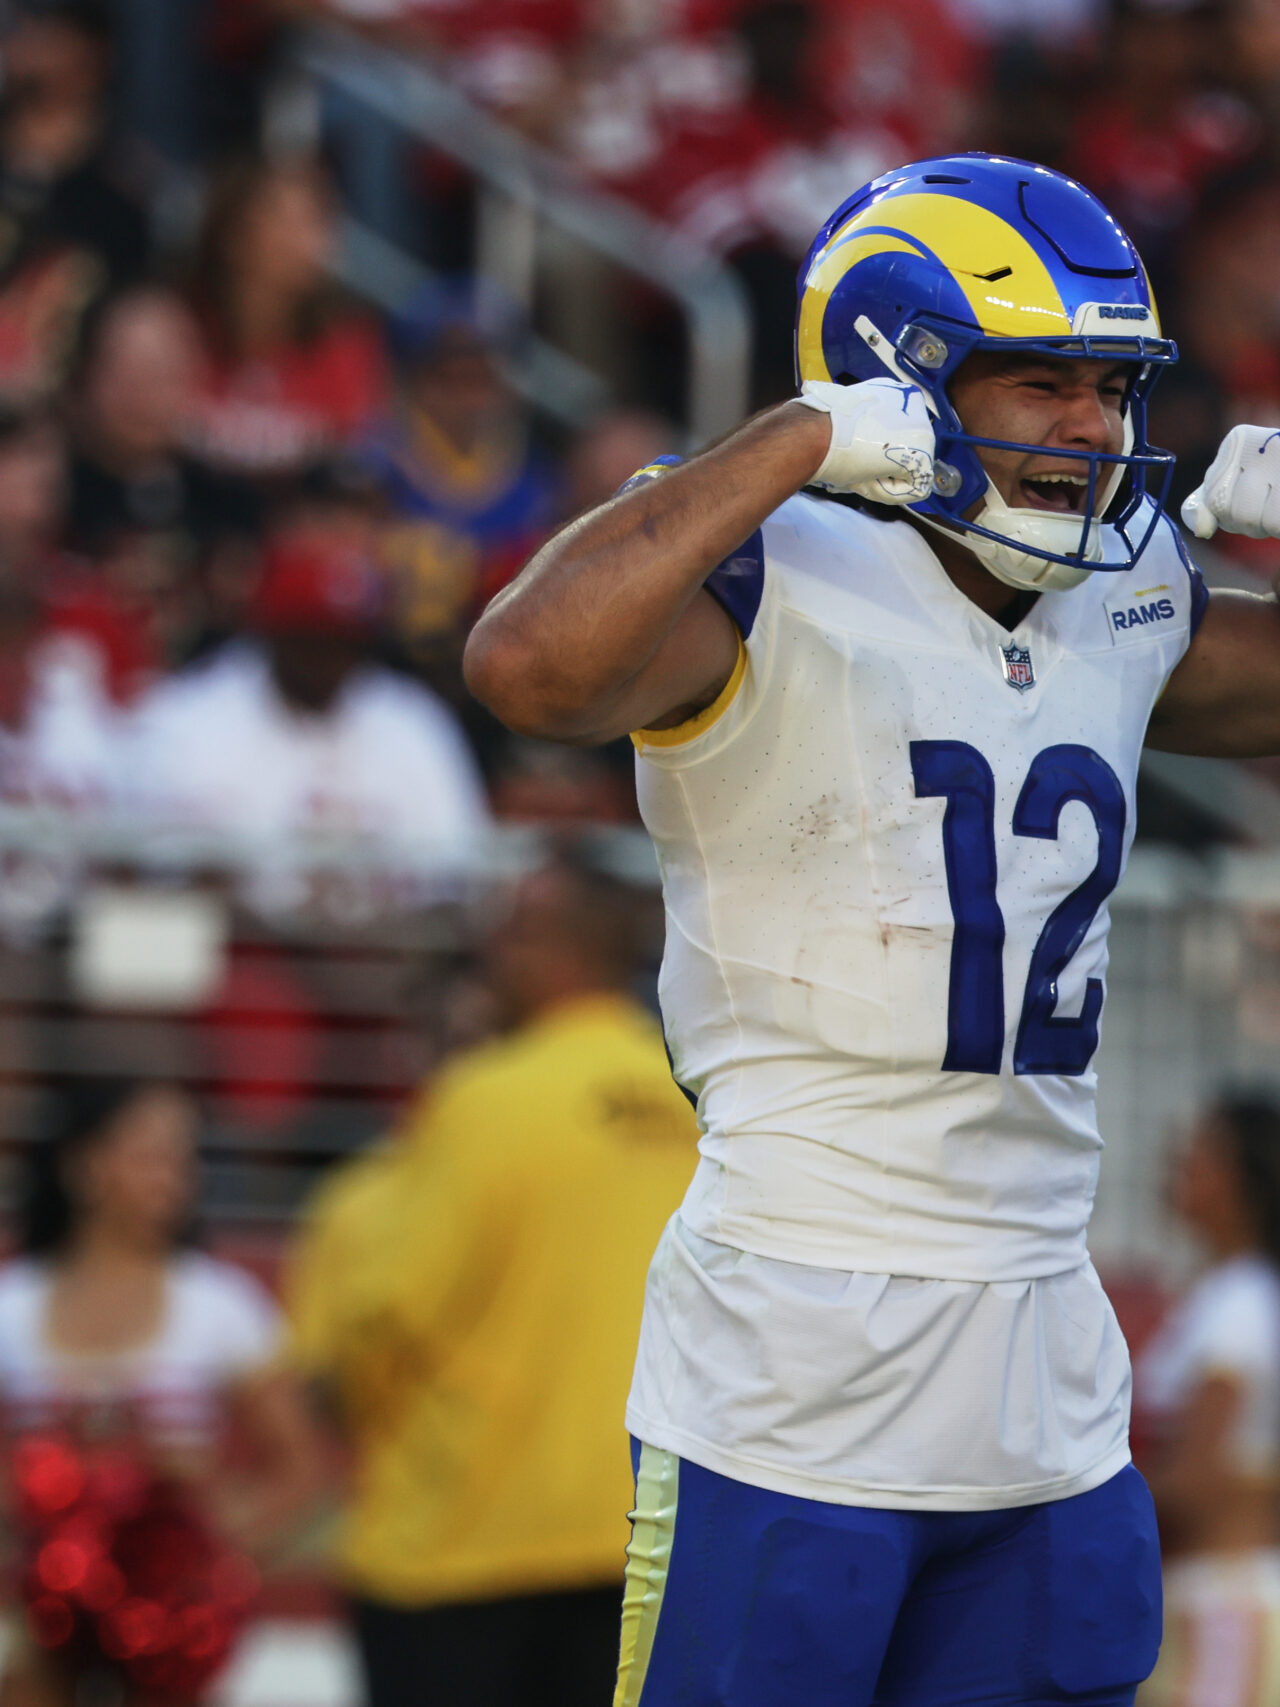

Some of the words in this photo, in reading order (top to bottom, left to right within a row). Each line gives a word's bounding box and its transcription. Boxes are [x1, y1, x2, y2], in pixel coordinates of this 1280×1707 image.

[1098, 306, 1149, 321] RAMS
[1111, 599, 1175, 631] RAMS
[1008, 664, 1032, 682] NFL
[909, 740, 1126, 1075] 12
